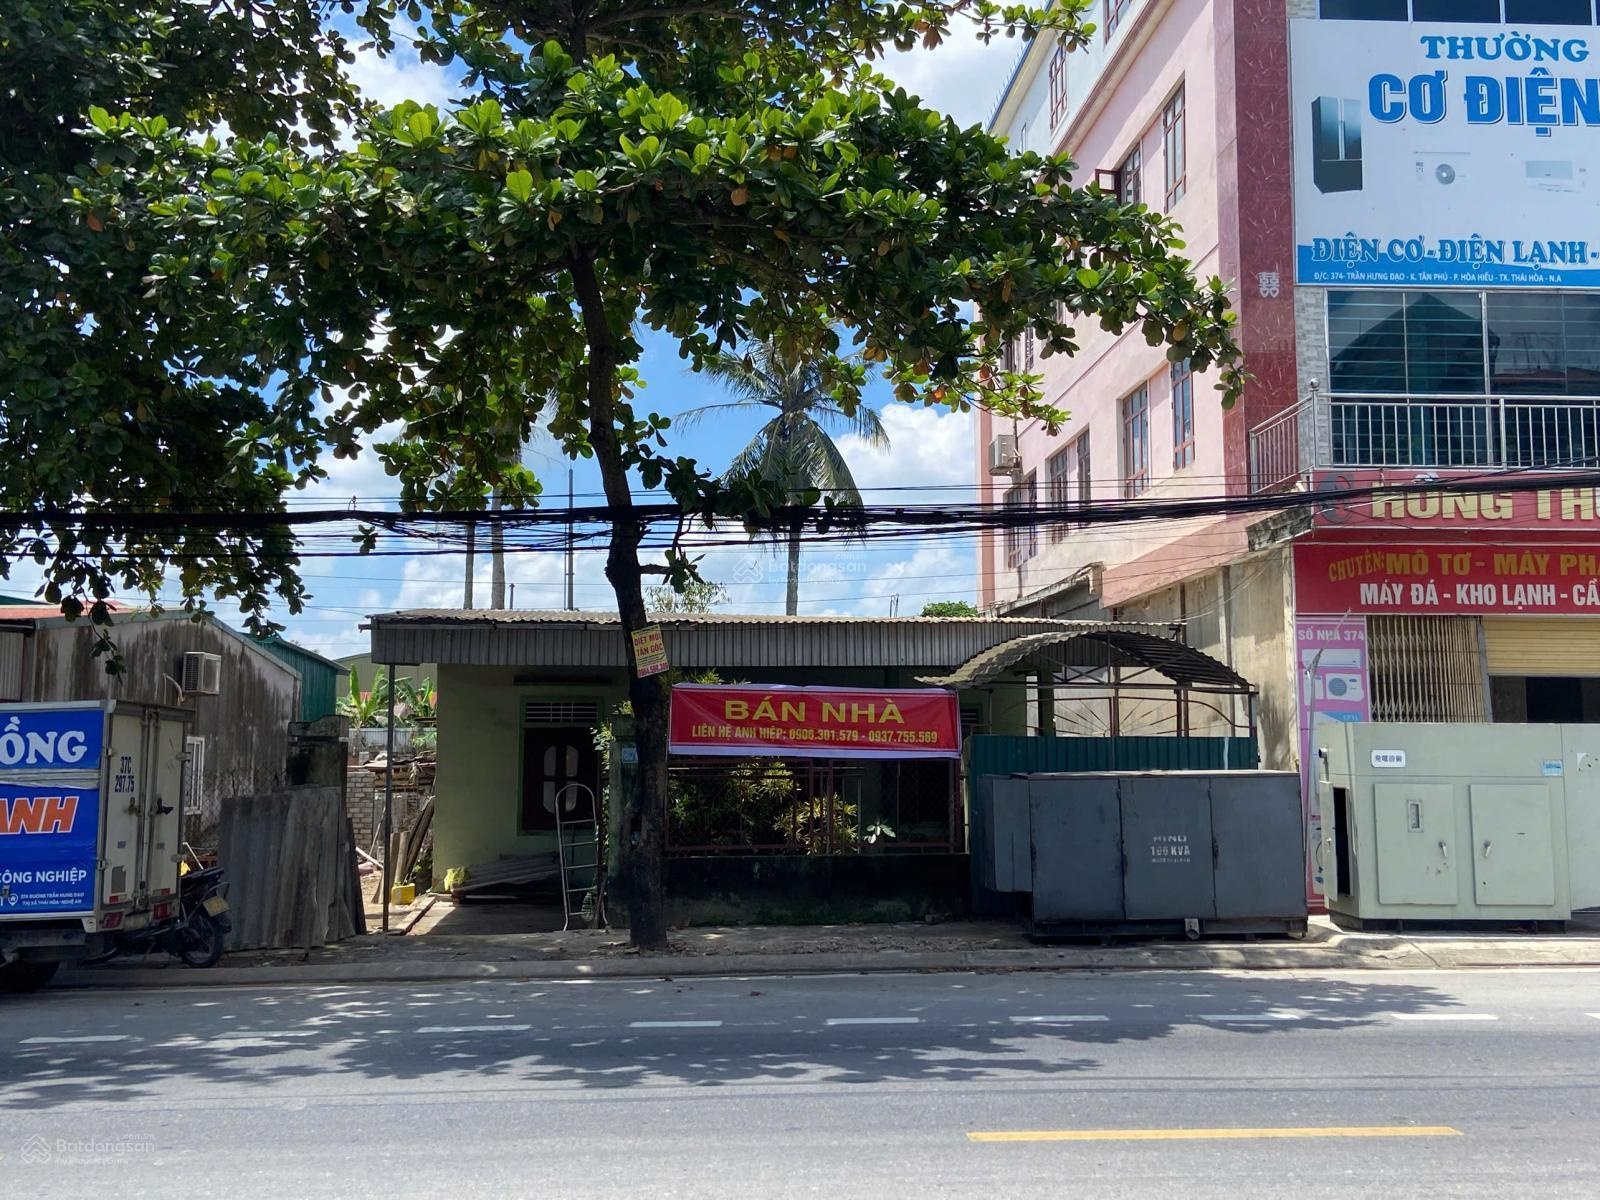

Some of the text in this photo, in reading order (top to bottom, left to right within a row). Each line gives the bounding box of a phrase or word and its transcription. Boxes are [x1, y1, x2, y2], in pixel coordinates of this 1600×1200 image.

[1420, 31, 1590, 62] THƯỜNG
[1368, 67, 1600, 137] CƠ ĐIỆN
[1311, 232, 1380, 268] ĐIỆN
[1531, 486, 1600, 521] TH
[1385, 549, 1429, 576] MÔ
[1437, 552, 1472, 576] TƠ
[1493, 550, 1550, 576] MÁY
[1560, 554, 1600, 576] PH
[1360, 578, 1404, 606] MÁY
[1410, 578, 1439, 606] ĐÁ
[1456, 583, 1497, 606] KHO
[1502, 583, 1557, 610] LẠNH
[1297, 625, 1314, 641] SỐ
[1343, 629, 1365, 641] 374
[725, 695, 905, 724] BÁN NHÀ
[0, 716, 88, 765] ỒNG
[734, 726, 756, 739] ANH
[120, 756, 132, 774] 37C
[1170, 845, 1190, 857] KVA
[0, 867, 87, 885] ÔNG NGHIỆP
